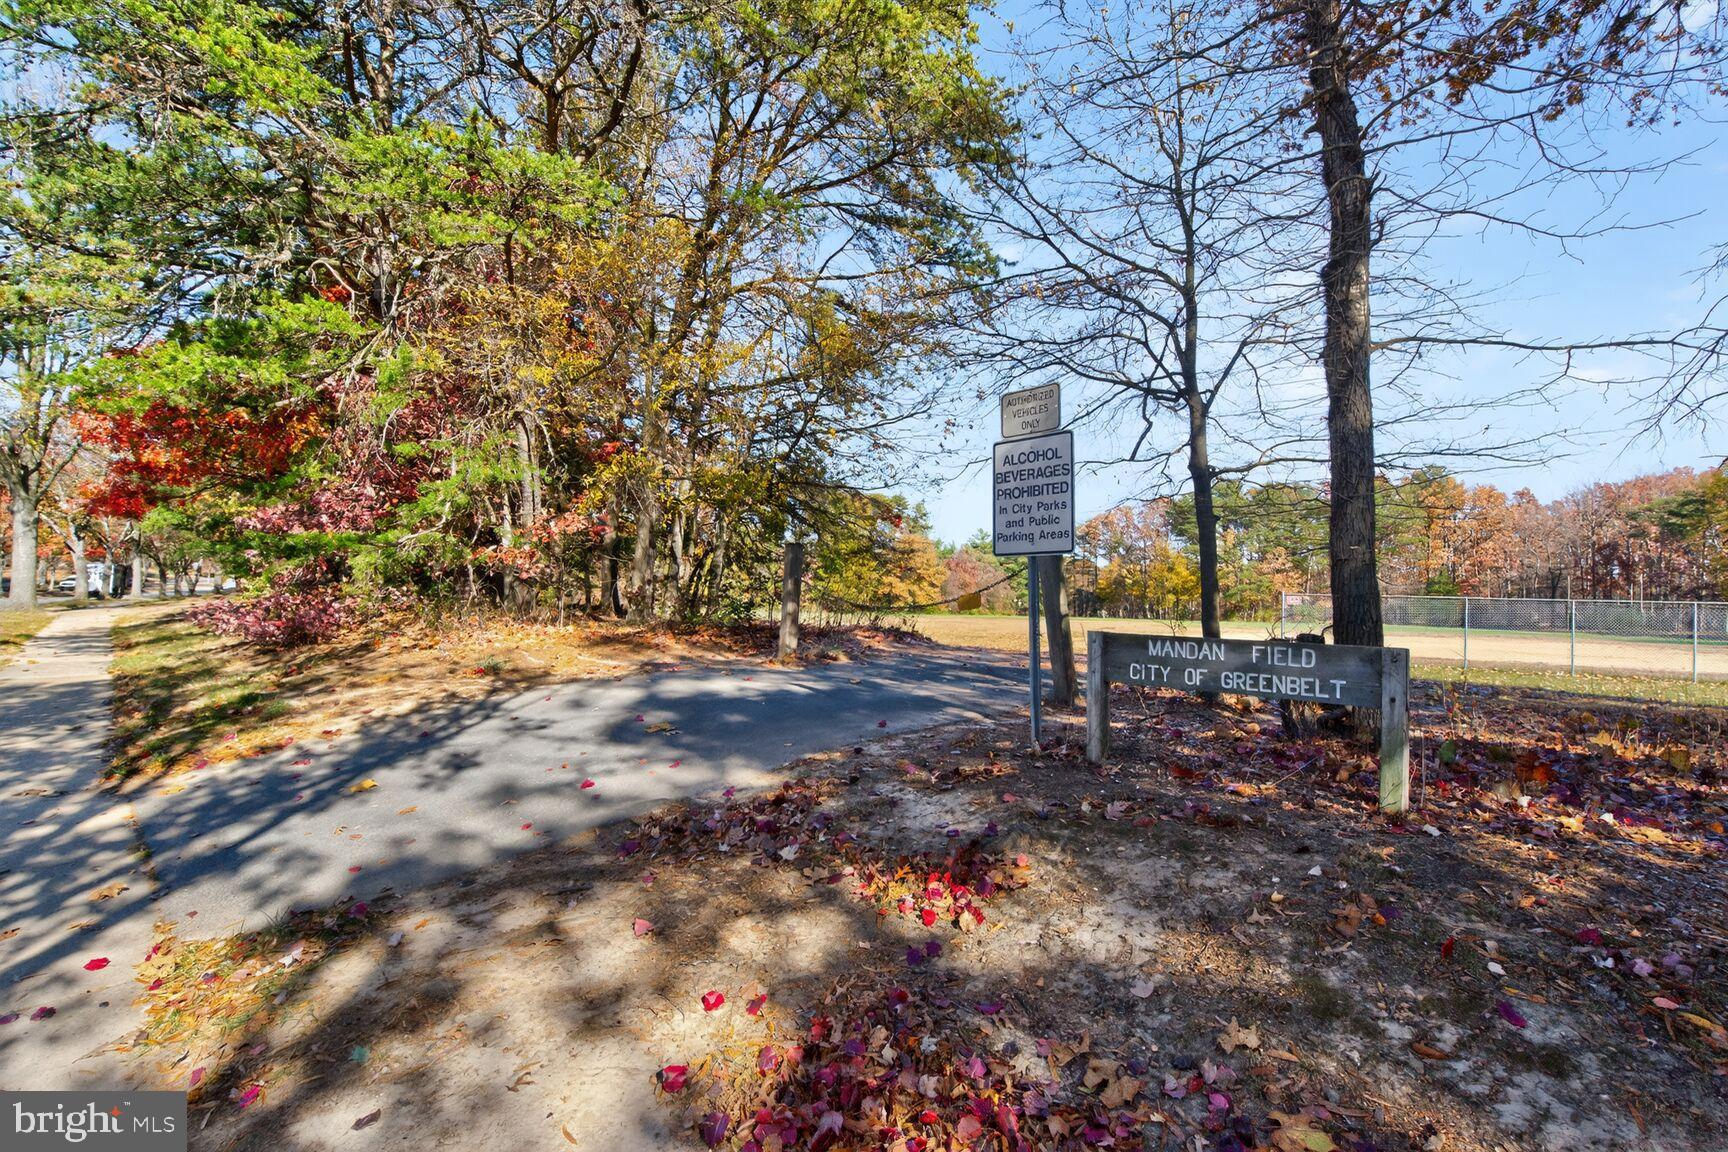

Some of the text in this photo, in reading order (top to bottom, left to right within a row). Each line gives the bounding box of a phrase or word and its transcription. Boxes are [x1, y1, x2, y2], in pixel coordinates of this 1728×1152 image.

[1006, 389, 1055, 408] AUTHORIZED
[1012, 403, 1049, 418] VEHICLES
[1021, 418, 1040, 430] ONLY
[1003, 448, 1062, 467] ALCOHOL
[996, 463, 1070, 484] BEVERAGES
[997, 481, 1069, 500] PROHIBITED
[1012, 502, 1032, 515] City
[1037, 500, 1067, 512] Parks
[1005, 515, 1060, 528] and Public
[997, 529, 1070, 544] Parking Areas
[1148, 639, 1316, 669] MANDAN FIELD
[1129, 663, 1347, 699] CITY OF GREENBELT
